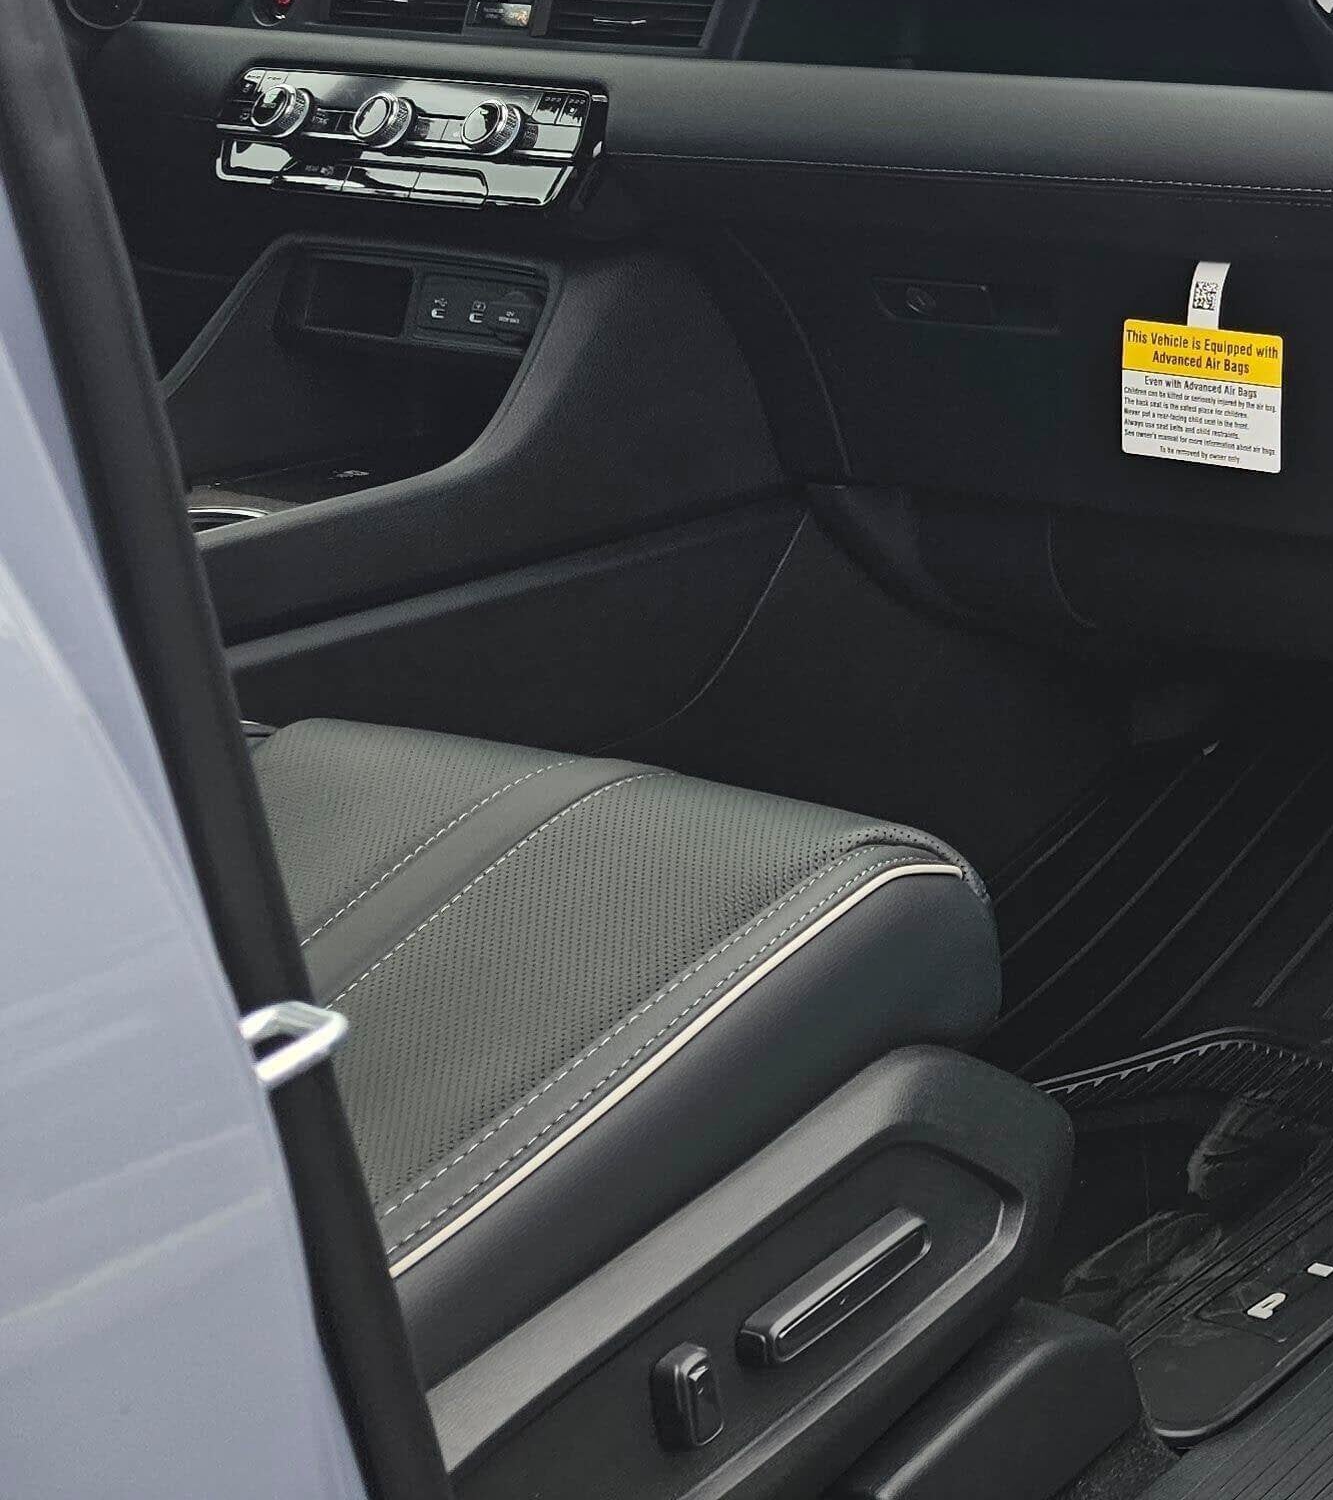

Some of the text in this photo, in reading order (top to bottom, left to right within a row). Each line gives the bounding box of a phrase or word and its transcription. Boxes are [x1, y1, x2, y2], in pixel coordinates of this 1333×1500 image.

[1126, 330, 1278, 359] This Vehicle is Equipped with
[1152, 350, 1250, 376] Advanced Air Bags
[1144, 376, 1257, 399] Even with Advanced Air Bags
